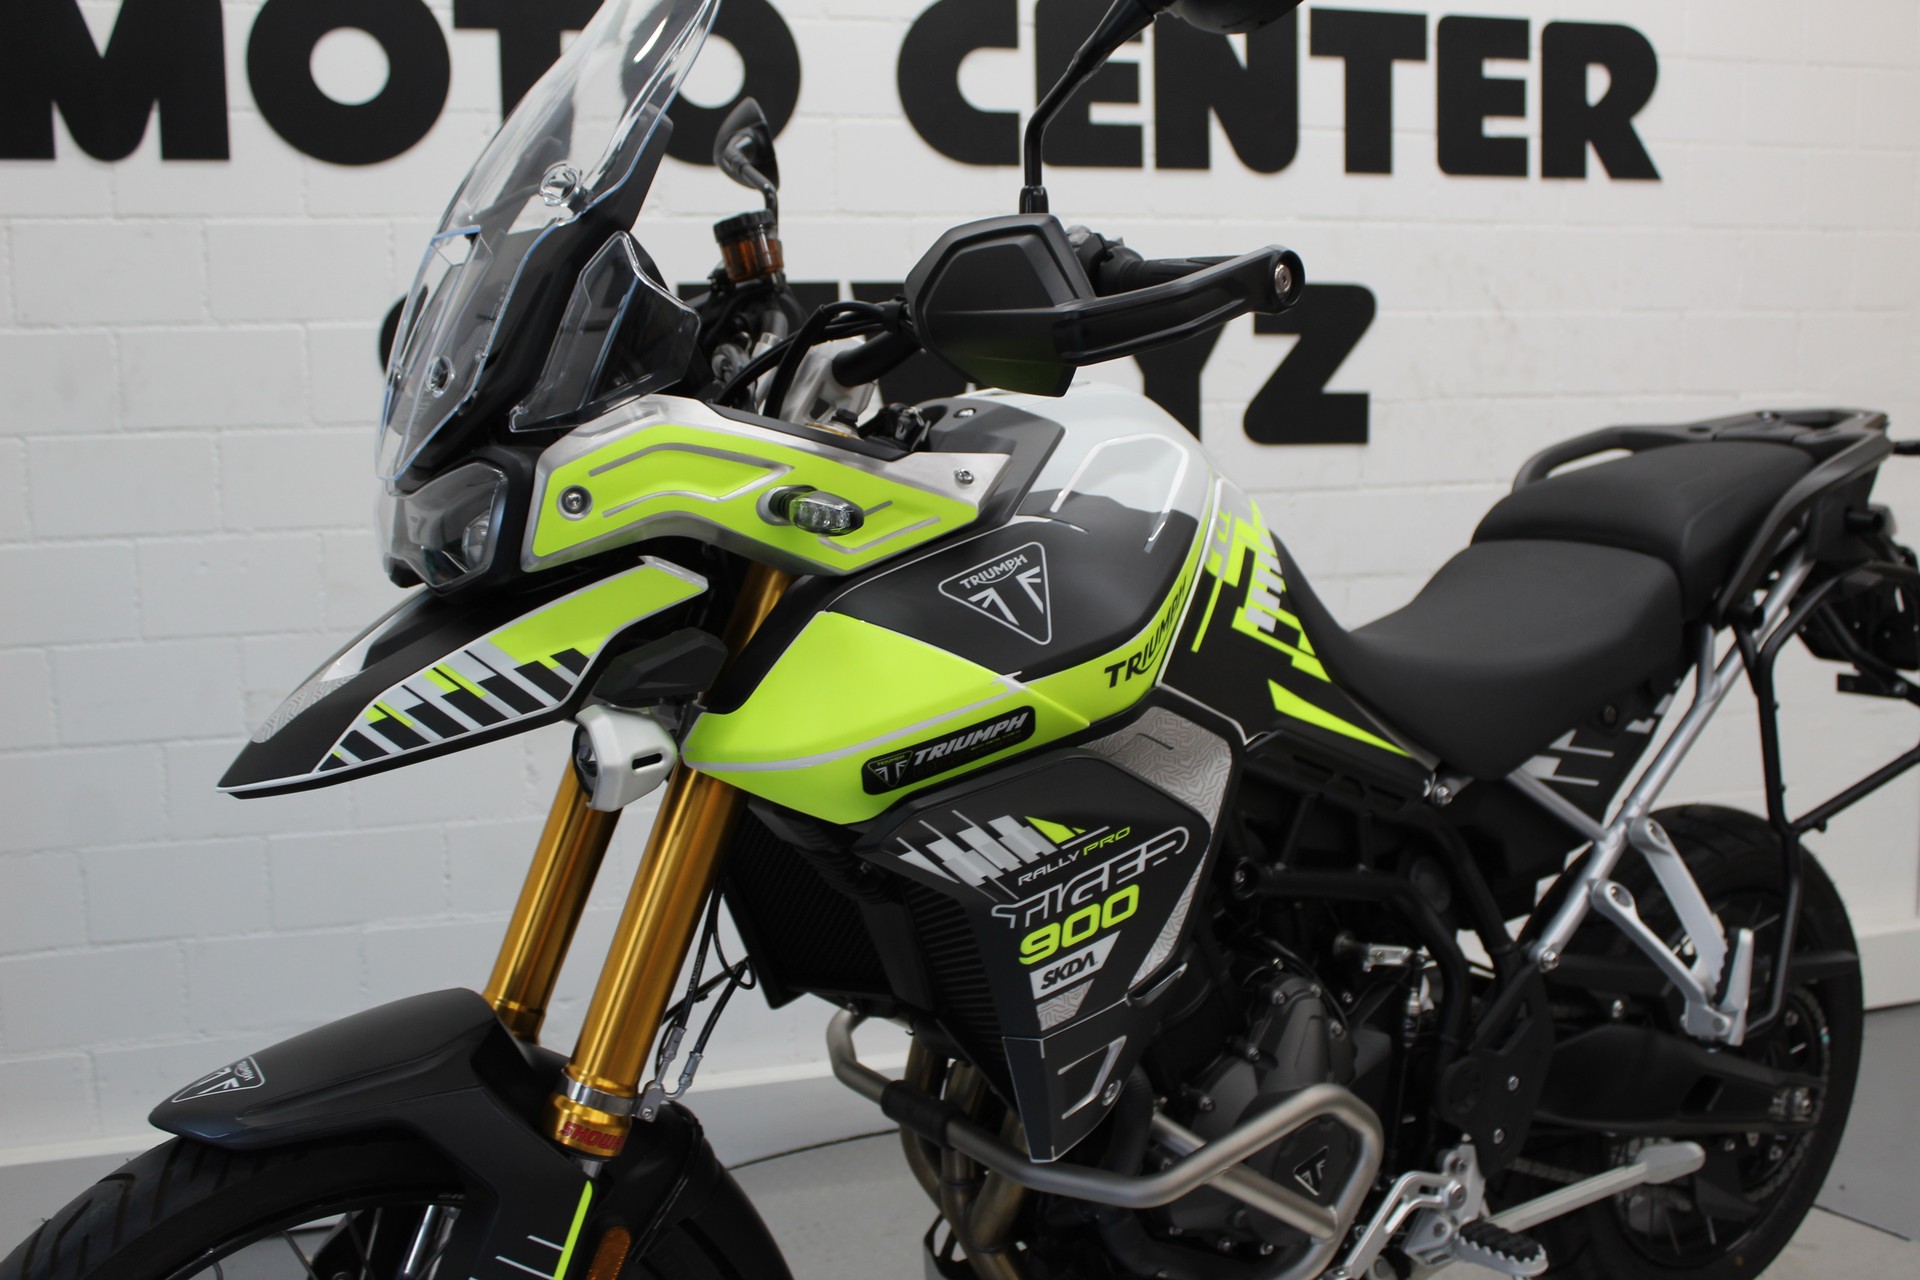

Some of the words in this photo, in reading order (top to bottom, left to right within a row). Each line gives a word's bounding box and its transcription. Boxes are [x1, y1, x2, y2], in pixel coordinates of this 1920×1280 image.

[0, 0, 800, 165] MOTO
[896, 0, 1661, 180] CENTER
[959, 554, 1028, 589] TRIUMPH
[1104, 574, 1187, 688] TRIUMPH
[914, 712, 1029, 766] TRIUMPH
[991, 826, 1190, 929] TIGER
[1018, 850, 1080, 886] RALLY
[1083, 826, 1131, 856] PRO
[1018, 884, 1140, 965] 900
